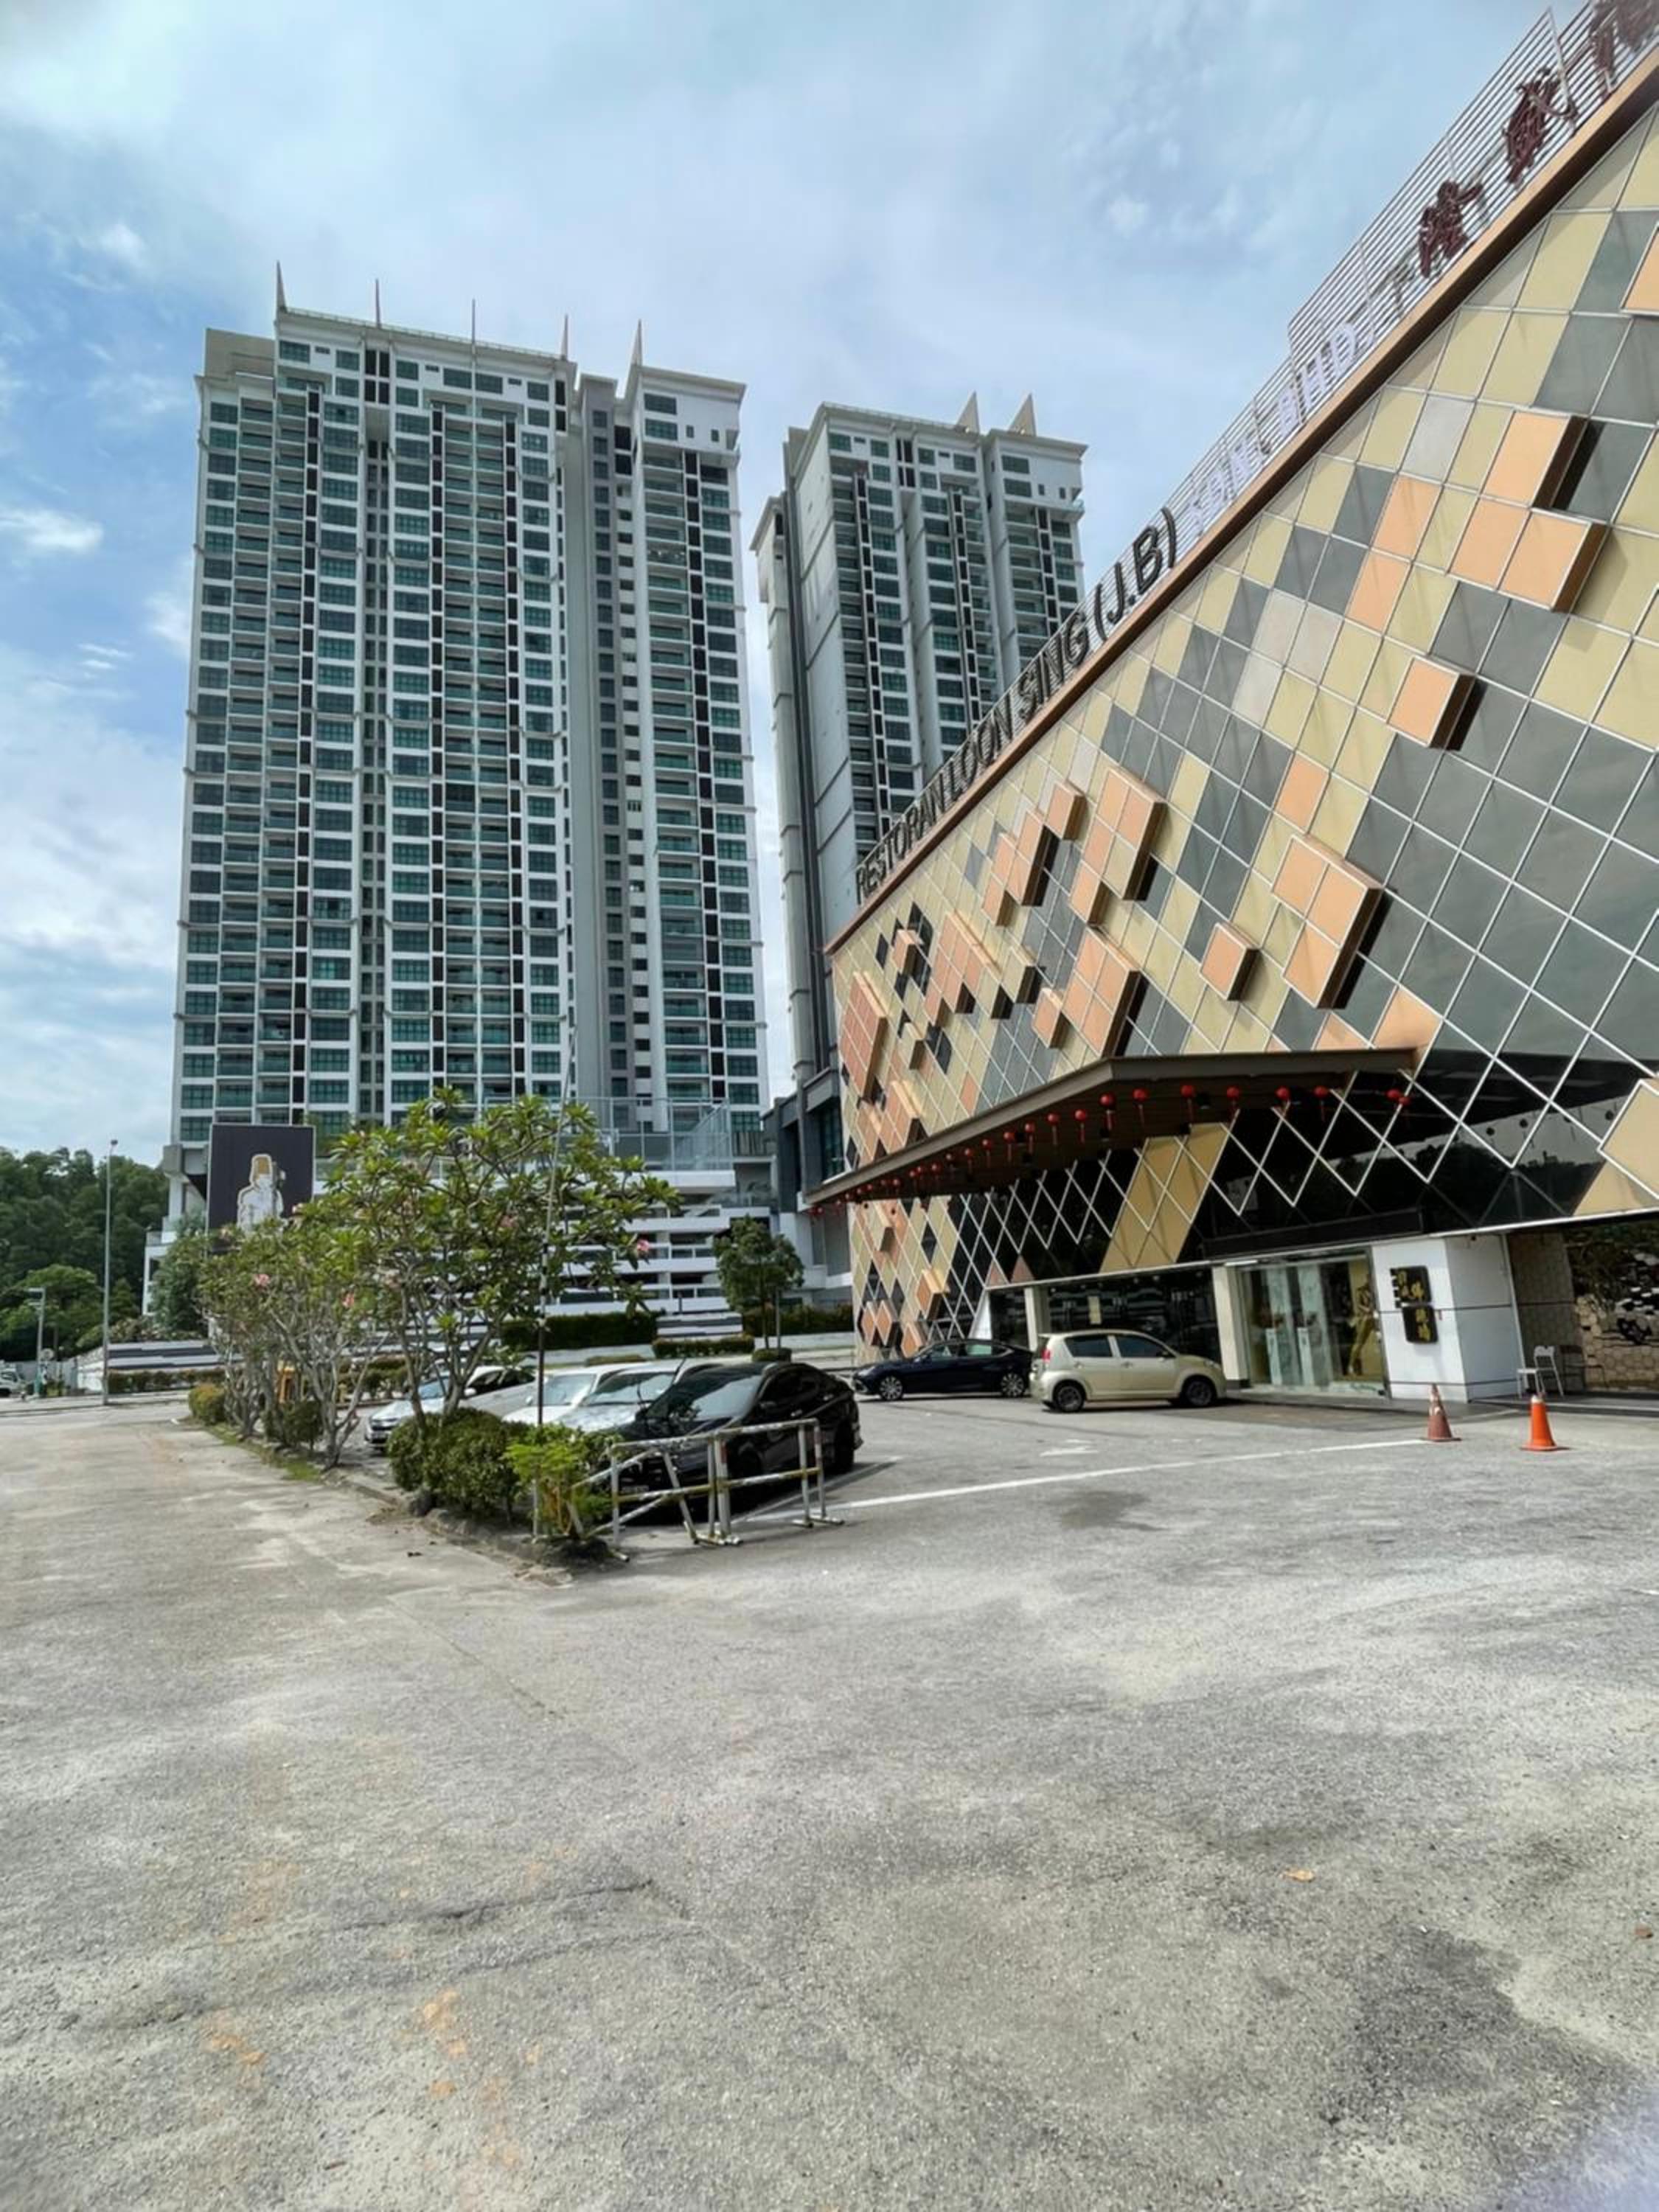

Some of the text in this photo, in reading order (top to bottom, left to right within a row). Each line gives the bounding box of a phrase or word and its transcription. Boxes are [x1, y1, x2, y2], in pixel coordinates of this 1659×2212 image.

[855, 771, 946, 906] RESTORAN
[949, 692, 1014, 801] LOON
[1018, 611, 1090, 726] SING
[1093, 506, 1178, 642] (J.B)
